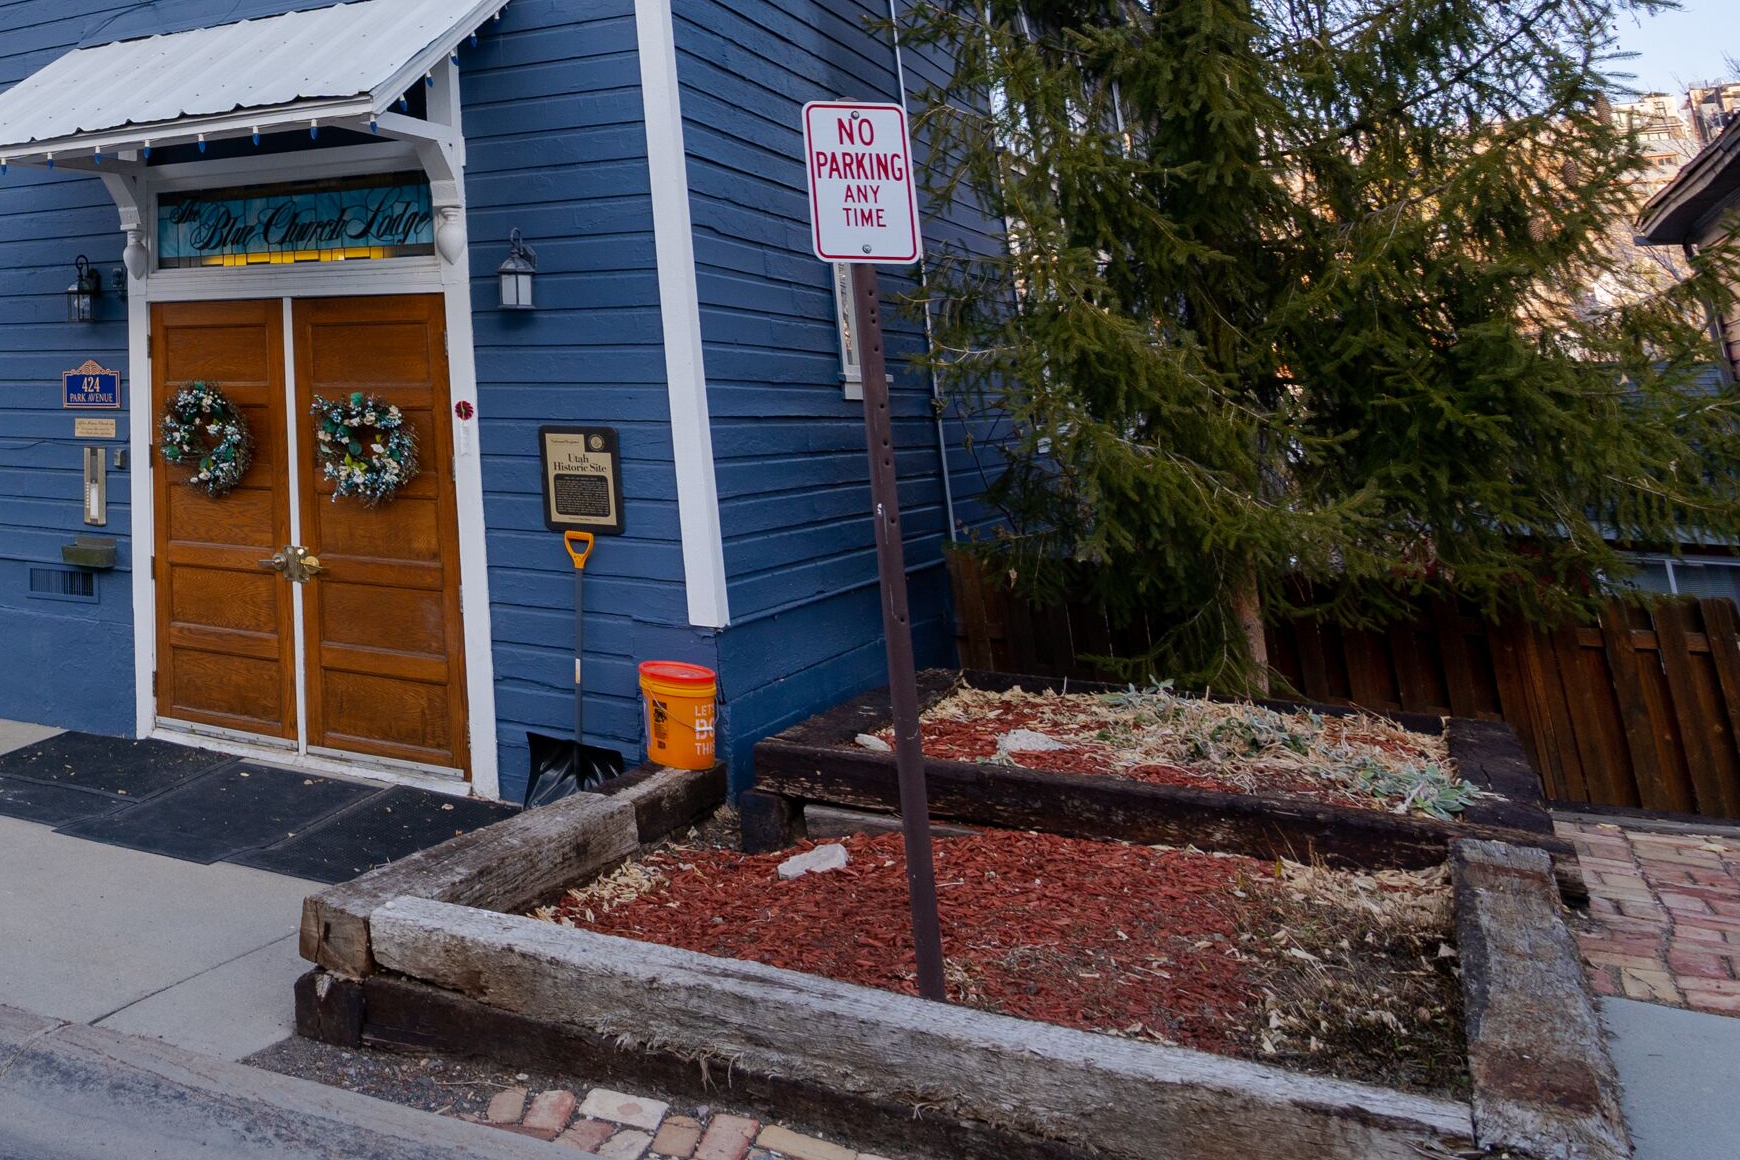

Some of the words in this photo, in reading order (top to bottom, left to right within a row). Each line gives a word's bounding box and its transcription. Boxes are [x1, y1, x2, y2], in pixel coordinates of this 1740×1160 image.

[837, 118, 875, 146] NO
[816, 151, 903, 181] PARKING
[844, 184, 881, 204] ANY
[169, 197, 201, 225] The
[190, 202, 258, 251] Blue
[258, 200, 347, 246] Church
[343, 185, 433, 245] Lodge
[842, 207, 887, 228] TIME
[82, 376, 100, 392] 424
[69, 393, 87, 402] PARK
[88, 393, 113, 402] AVENUE
[553, 461, 588, 472] Historic
[589, 463, 607, 473] Site
[567, 453, 589, 463] Utah
